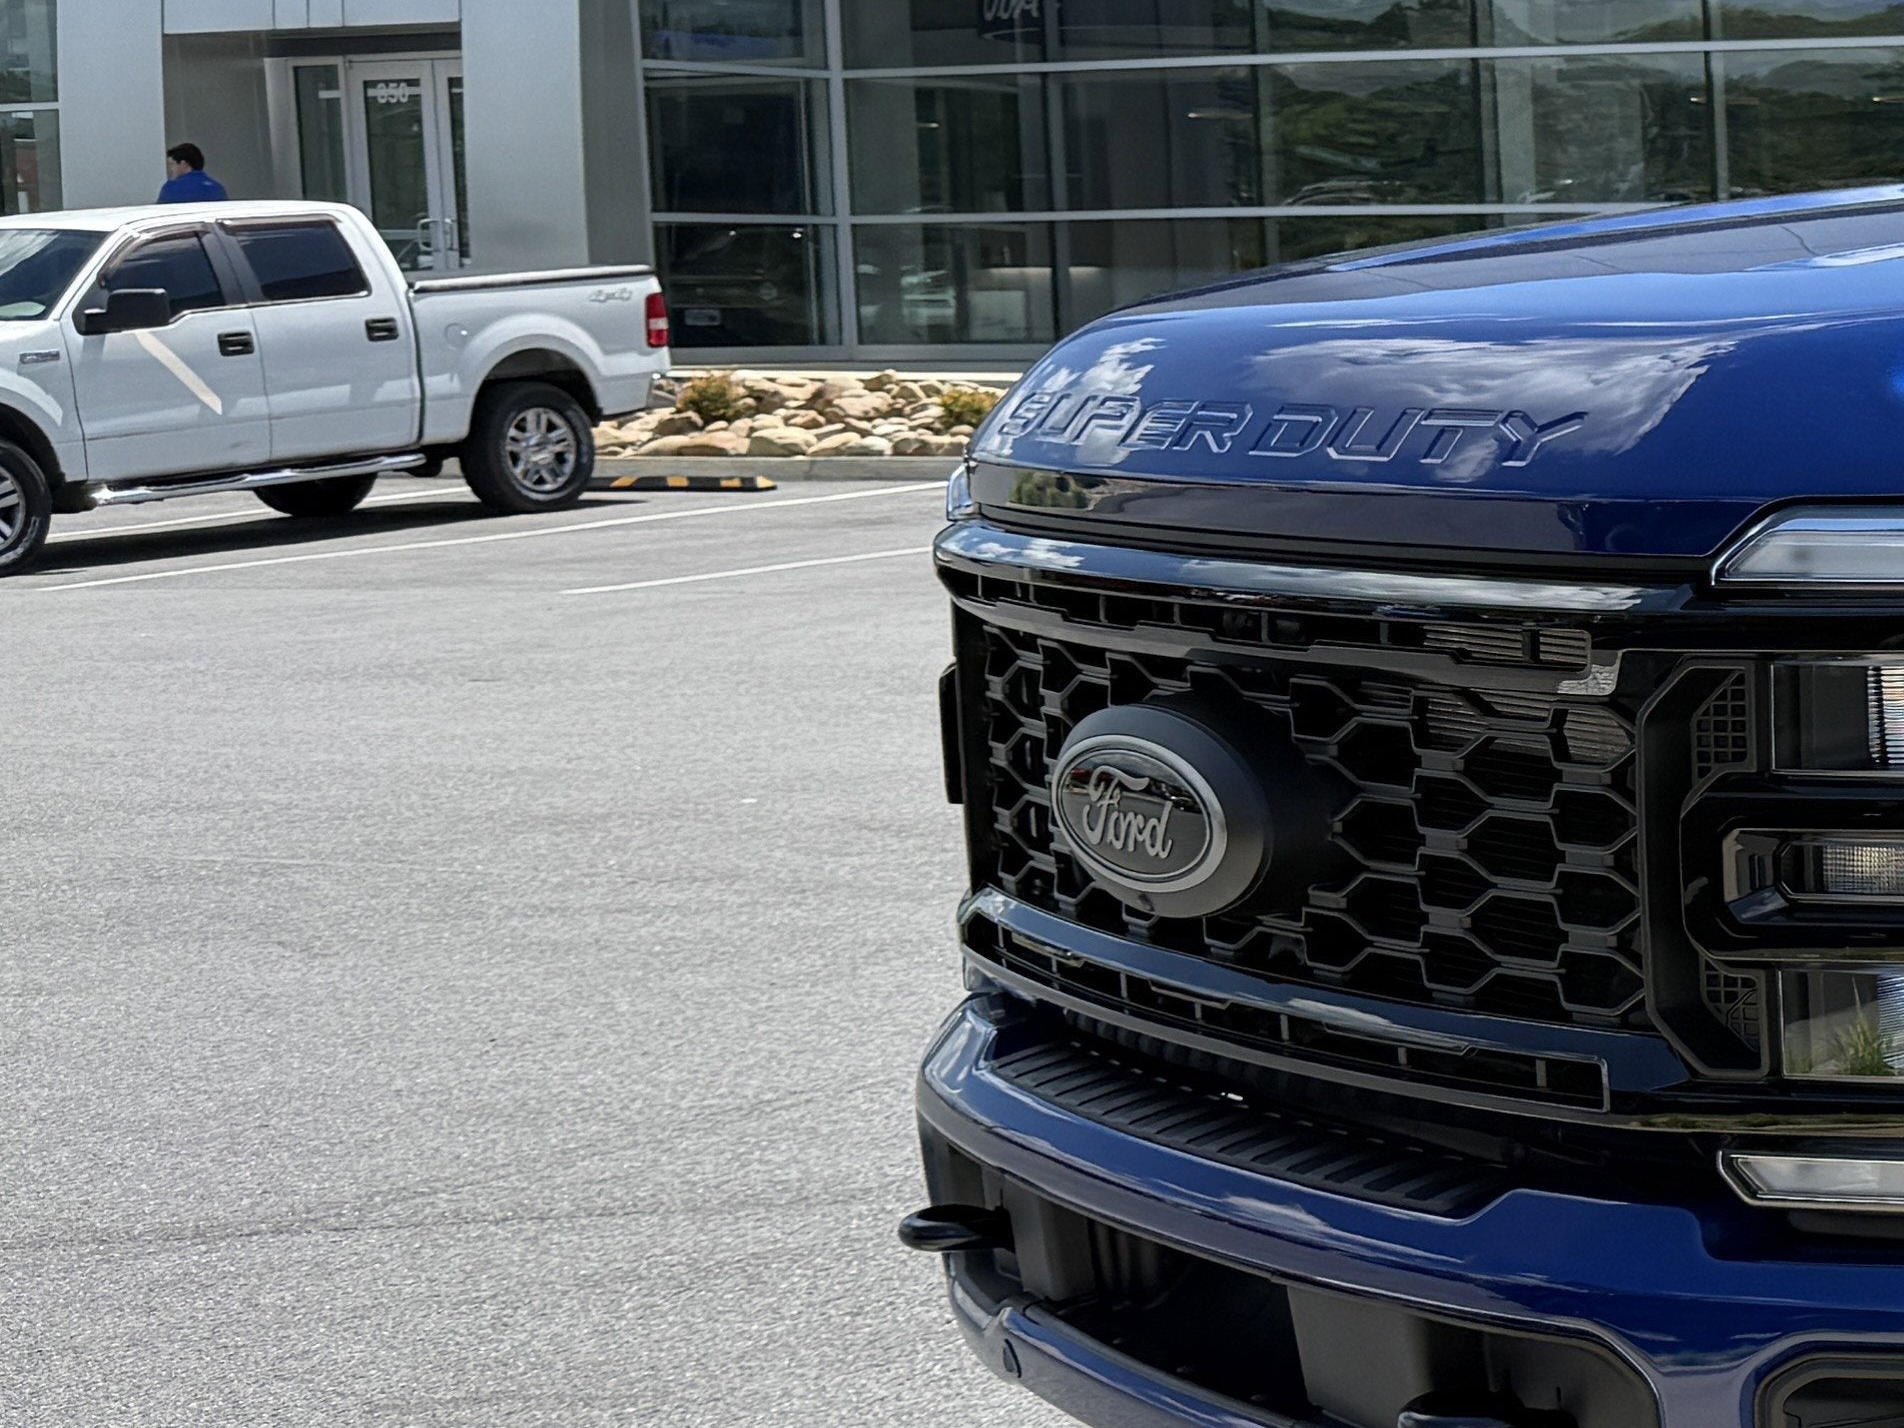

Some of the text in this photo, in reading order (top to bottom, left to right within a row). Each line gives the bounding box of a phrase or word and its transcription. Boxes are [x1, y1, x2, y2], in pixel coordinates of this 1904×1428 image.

[1001, 391, 1588, 467] SUPER DUTY
[1083, 765, 1173, 859] Ford
